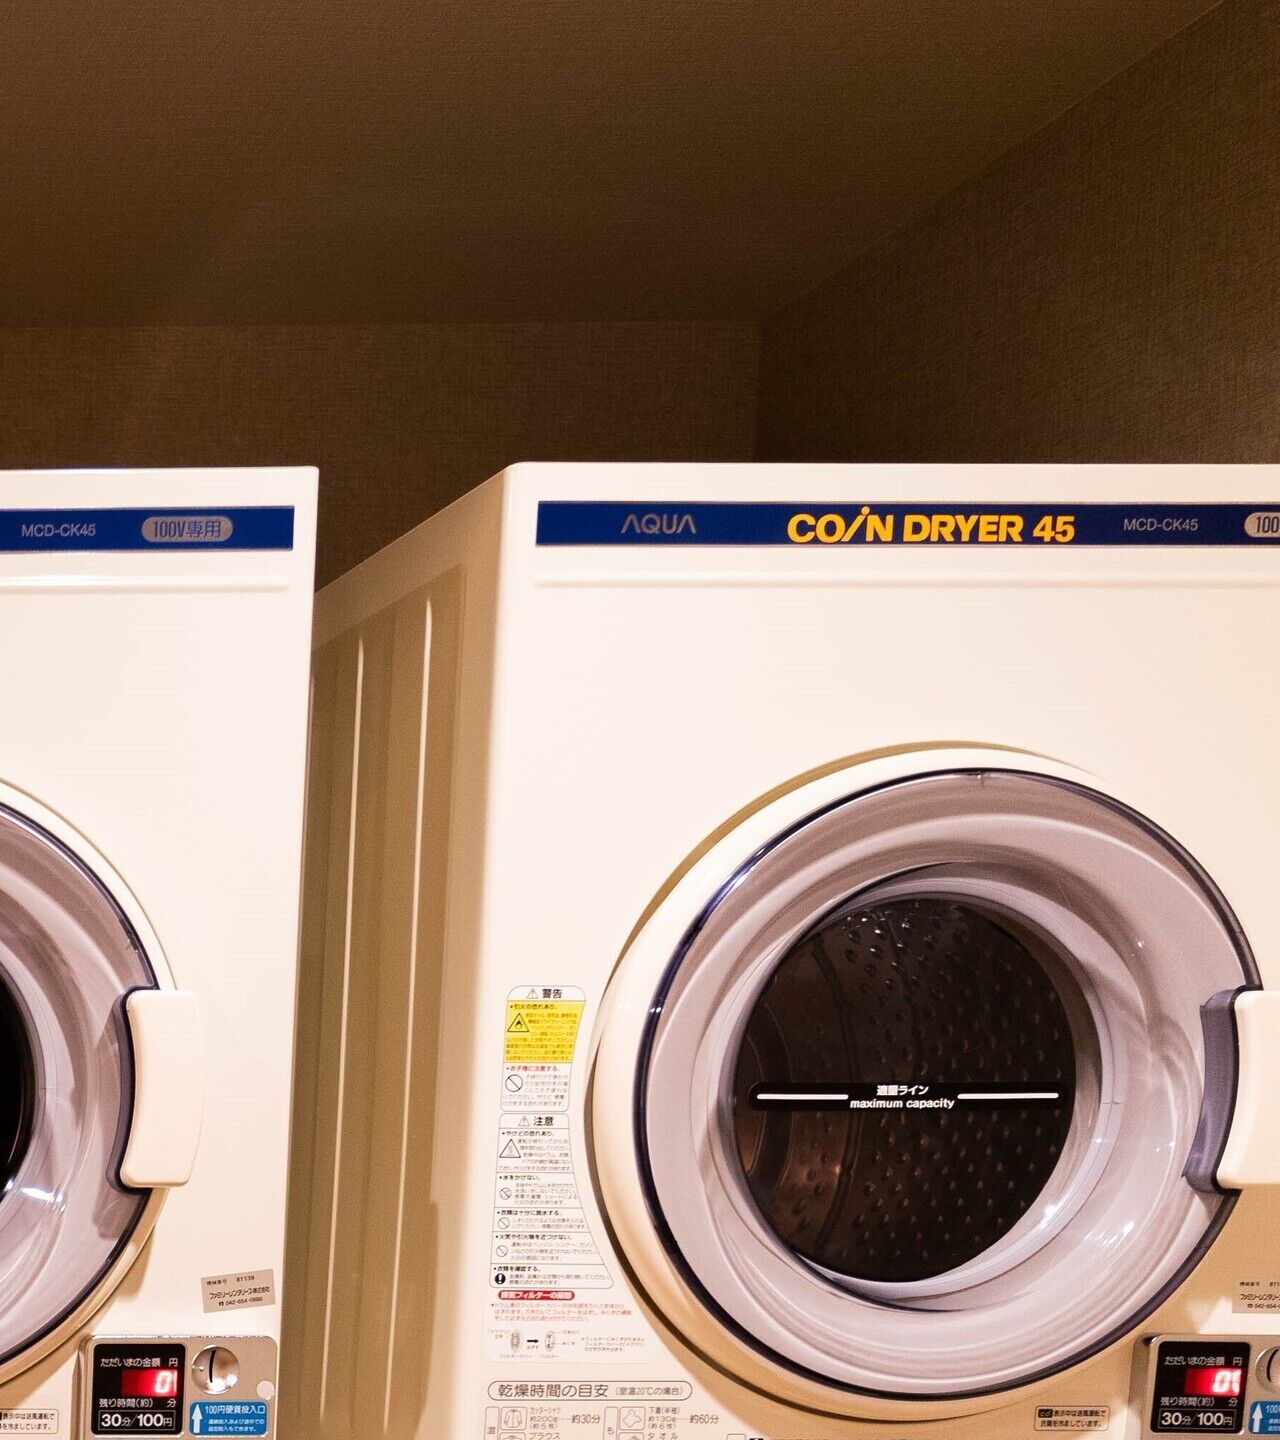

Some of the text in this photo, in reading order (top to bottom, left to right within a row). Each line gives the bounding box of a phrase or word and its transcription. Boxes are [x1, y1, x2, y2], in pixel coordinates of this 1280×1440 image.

[22, 524, 95, 537] MCD-CK45
[621, 514, 697, 534] AQUA
[904, 515, 1023, 542] DRYER
[1033, 515, 1074, 541] 45
[1124, 519, 1198, 531] MCD-CK45
[542, 989, 562, 999] 警告
[851, 1099, 954, 1109] maximum capacity
[534, 1116, 553, 1126] 注意
[498, 1384, 608, 1397] 乾燥時間の目安
